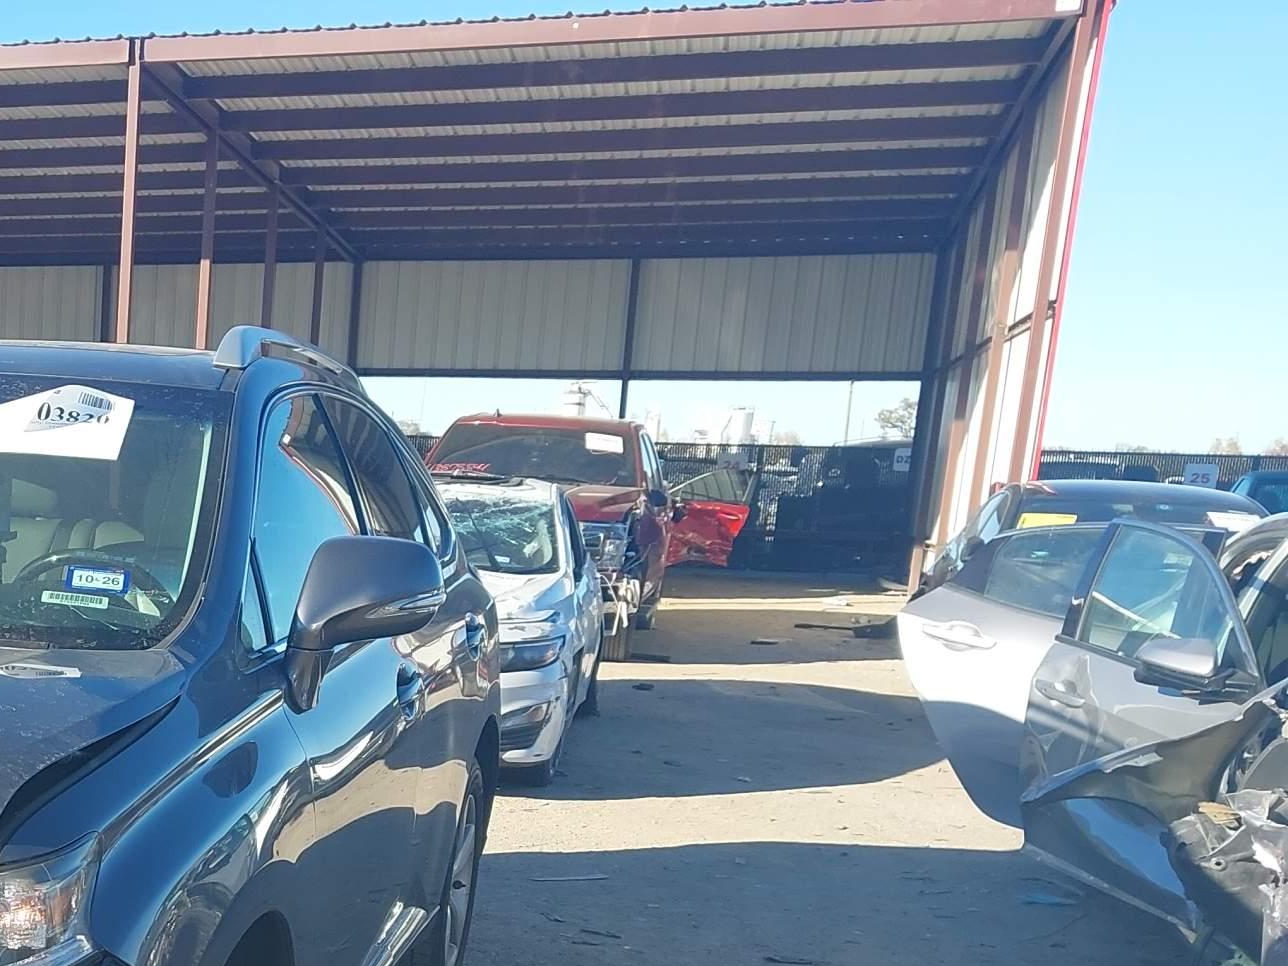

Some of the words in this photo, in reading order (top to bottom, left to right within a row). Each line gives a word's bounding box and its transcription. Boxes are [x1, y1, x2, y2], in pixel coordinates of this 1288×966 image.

[37, 402, 110, 424] 03820
[1190, 472, 1210, 484] 25
[76, 574, 120, 586] 10-26
